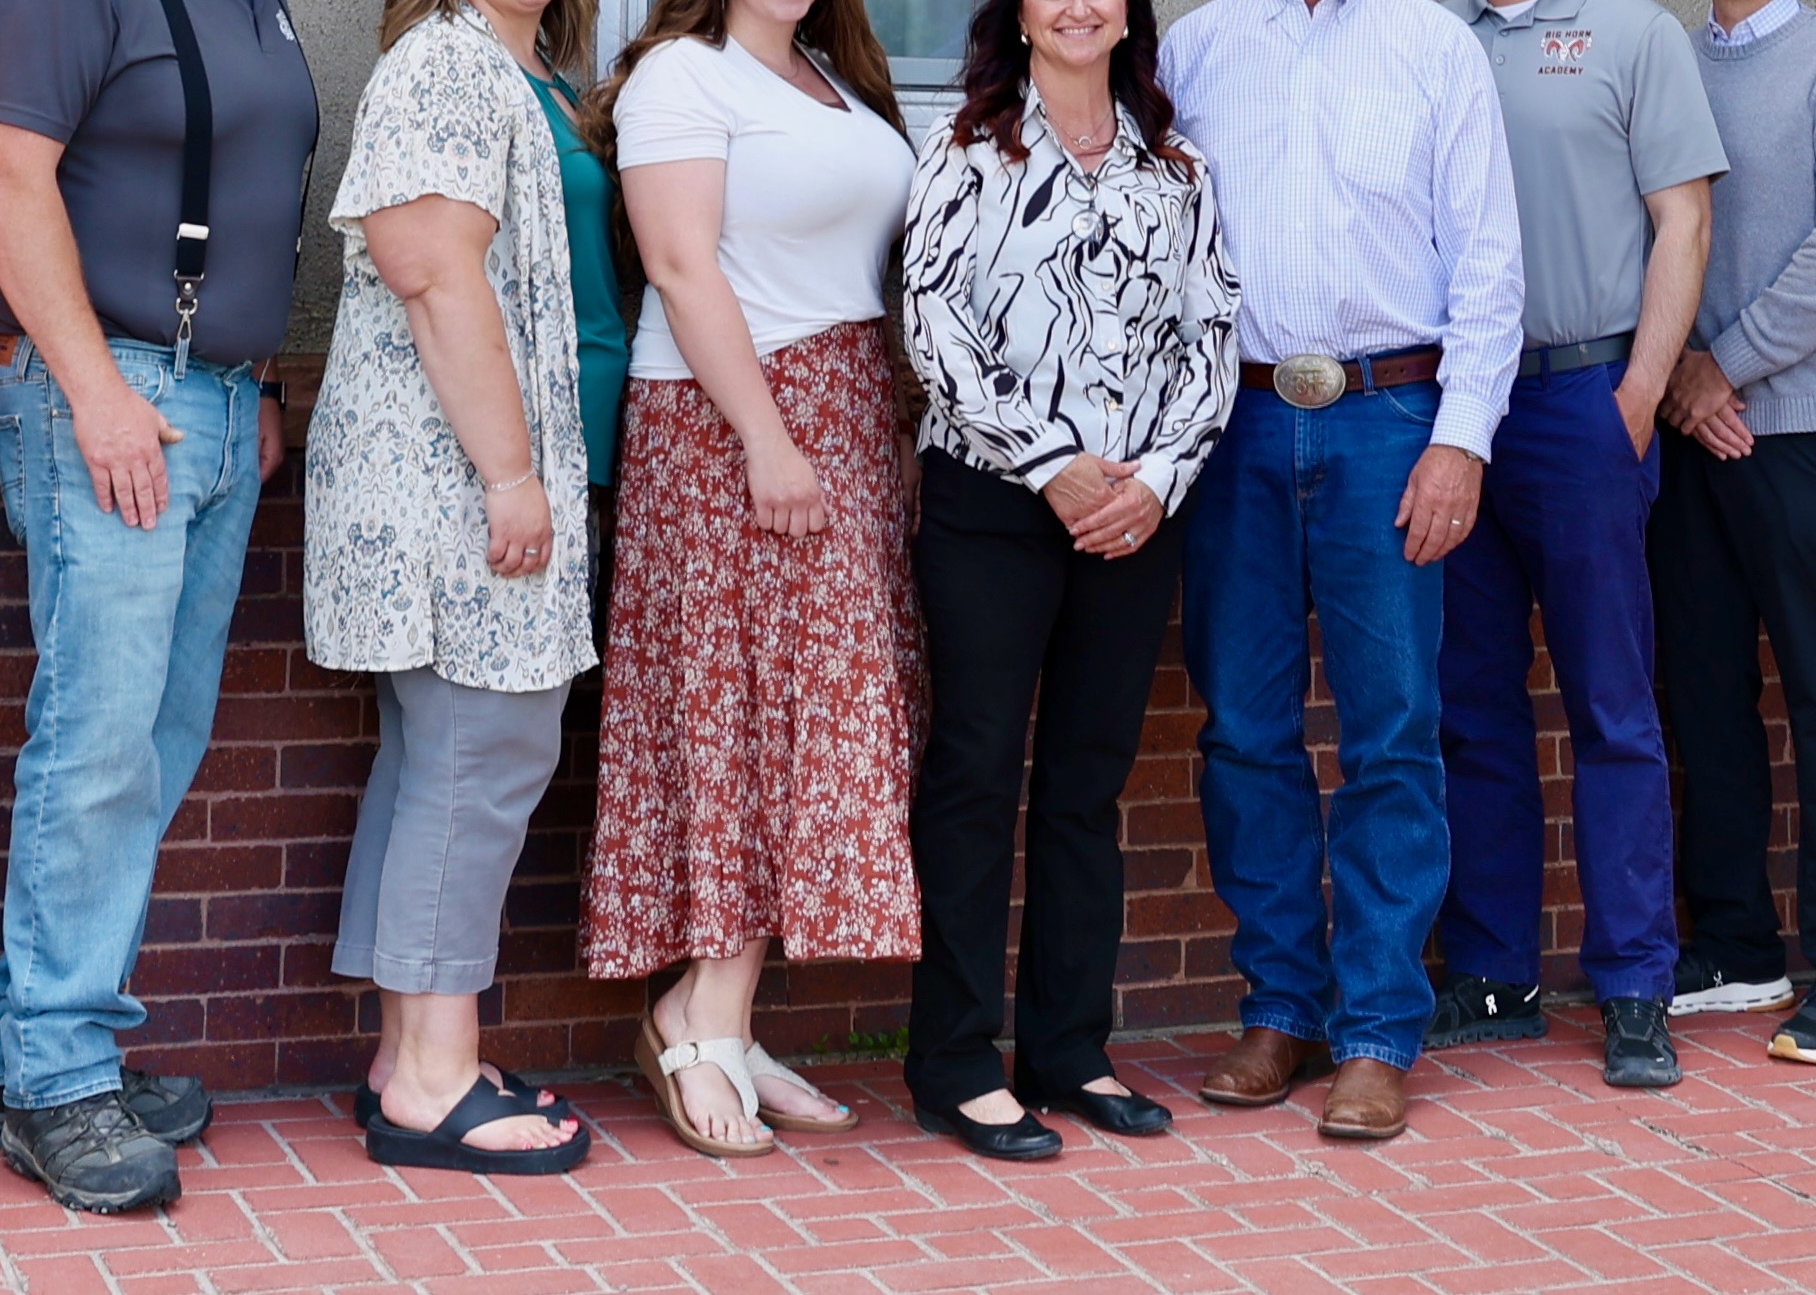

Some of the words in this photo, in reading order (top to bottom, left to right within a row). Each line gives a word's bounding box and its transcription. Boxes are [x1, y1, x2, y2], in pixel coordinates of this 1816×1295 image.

[1545, 30, 1562, 38] BIG
[1565, 30, 1592, 38] HORN
[1537, 66, 1584, 75] ACADEMY
